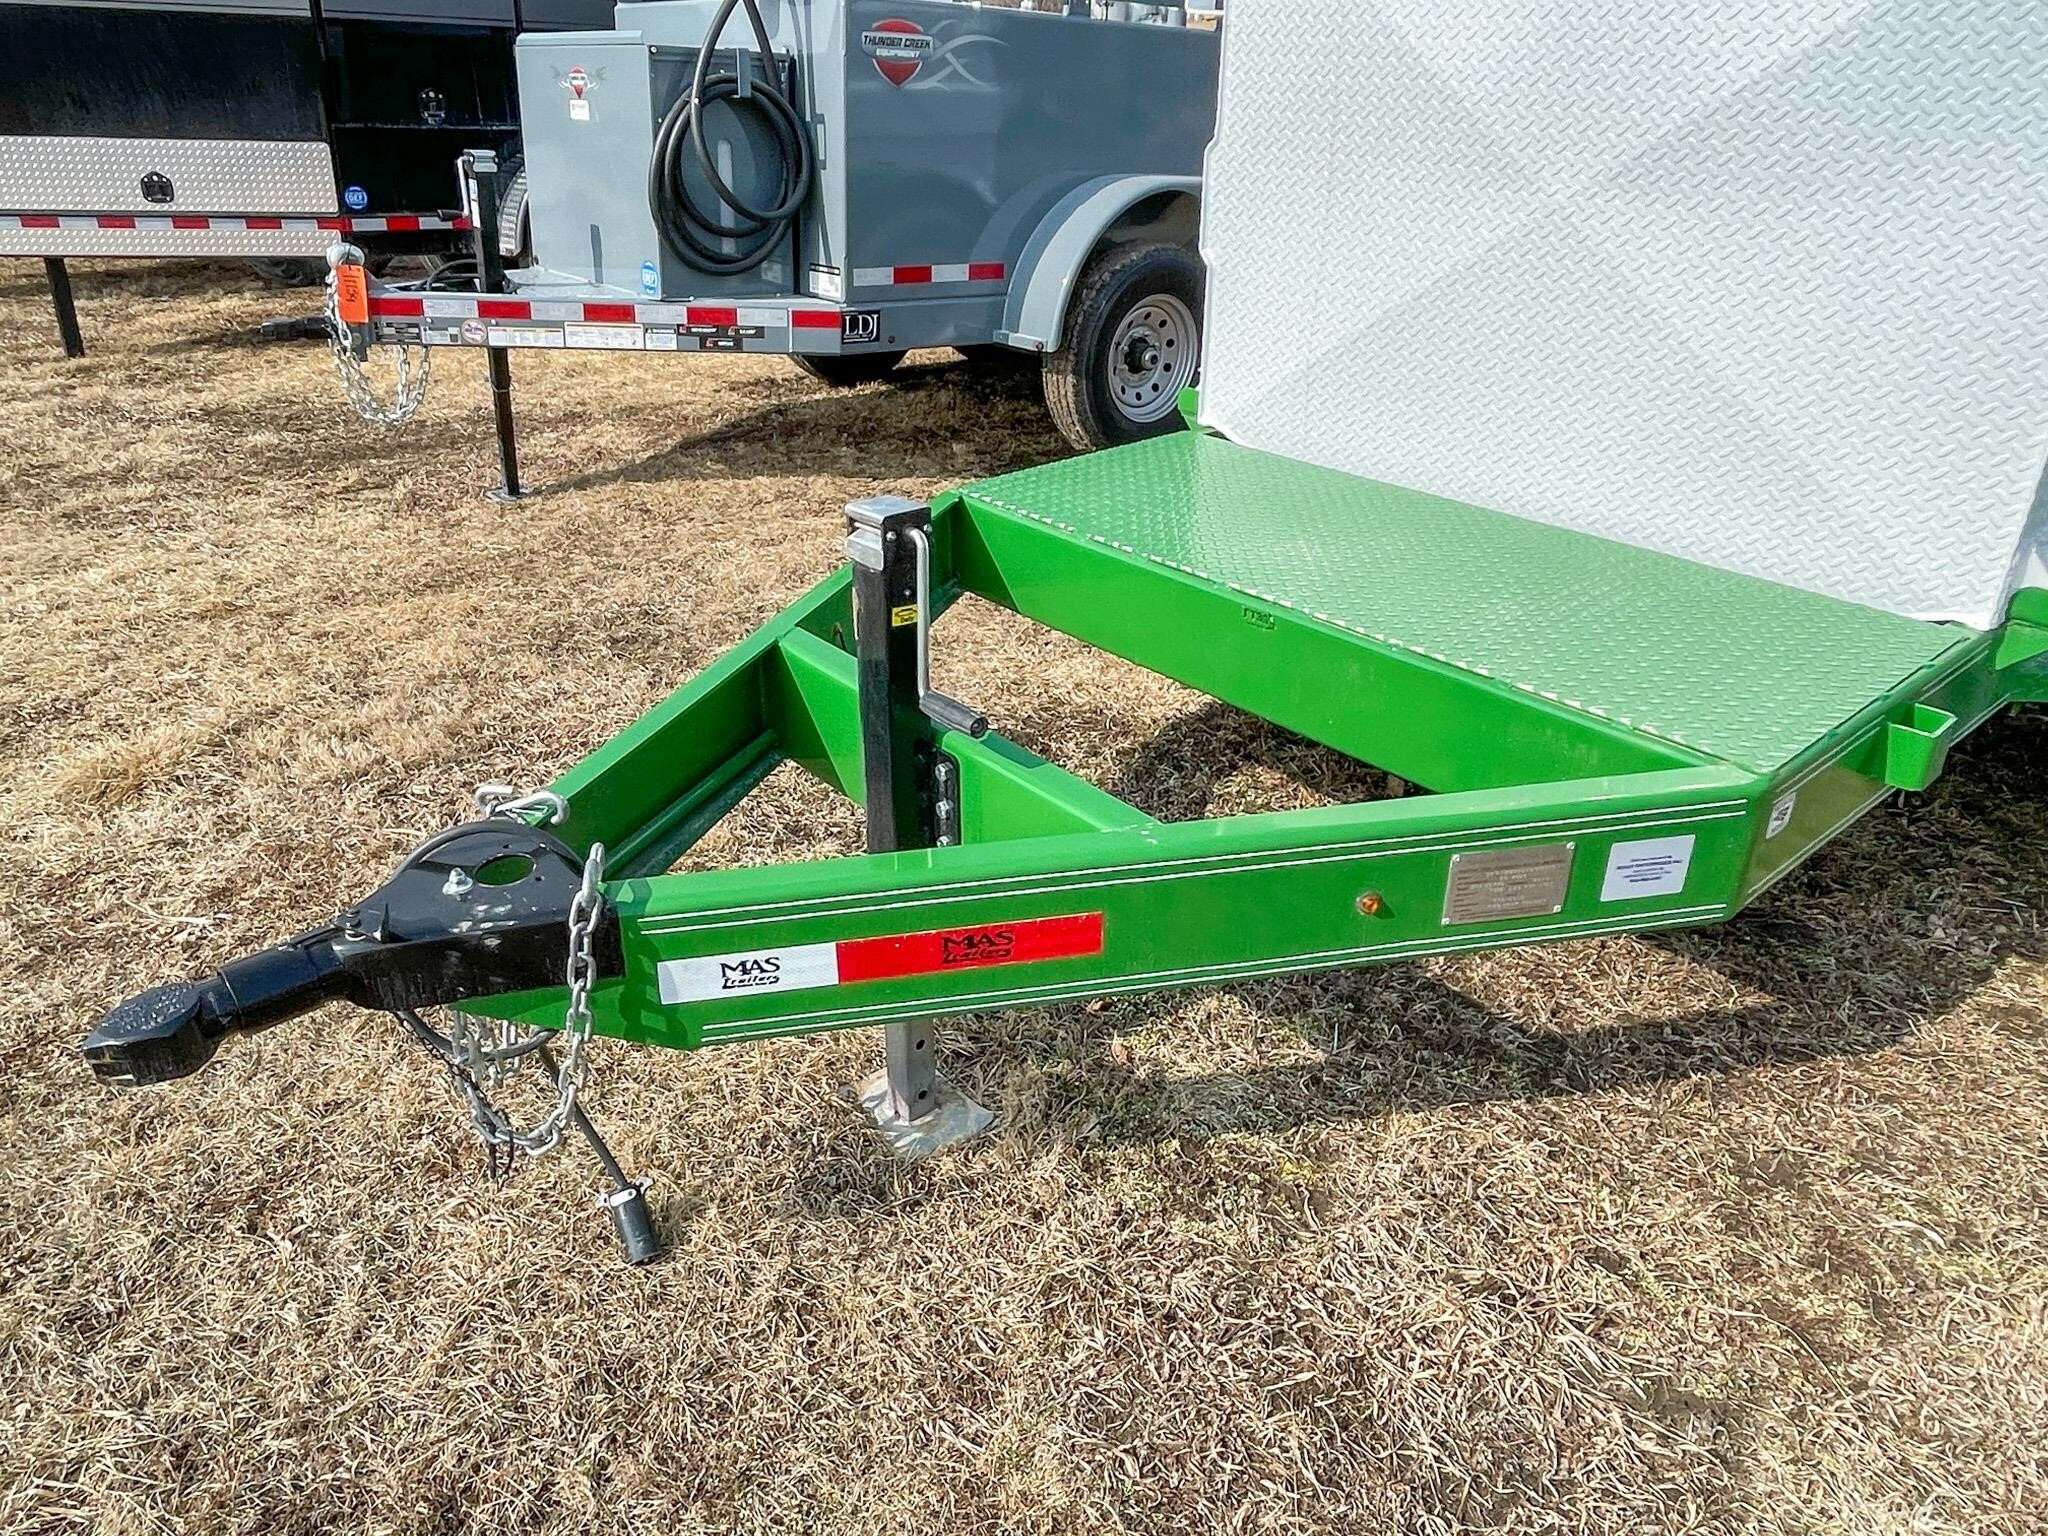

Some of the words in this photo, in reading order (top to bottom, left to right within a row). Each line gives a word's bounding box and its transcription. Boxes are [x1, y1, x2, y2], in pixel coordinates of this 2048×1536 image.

[863, 35, 902, 47] THUNDER
[904, 38, 931, 49] CREEK
[844, 314, 879, 341] LDJ
[943, 930, 1015, 952] MAS
[720, 957, 781, 977] MAS
